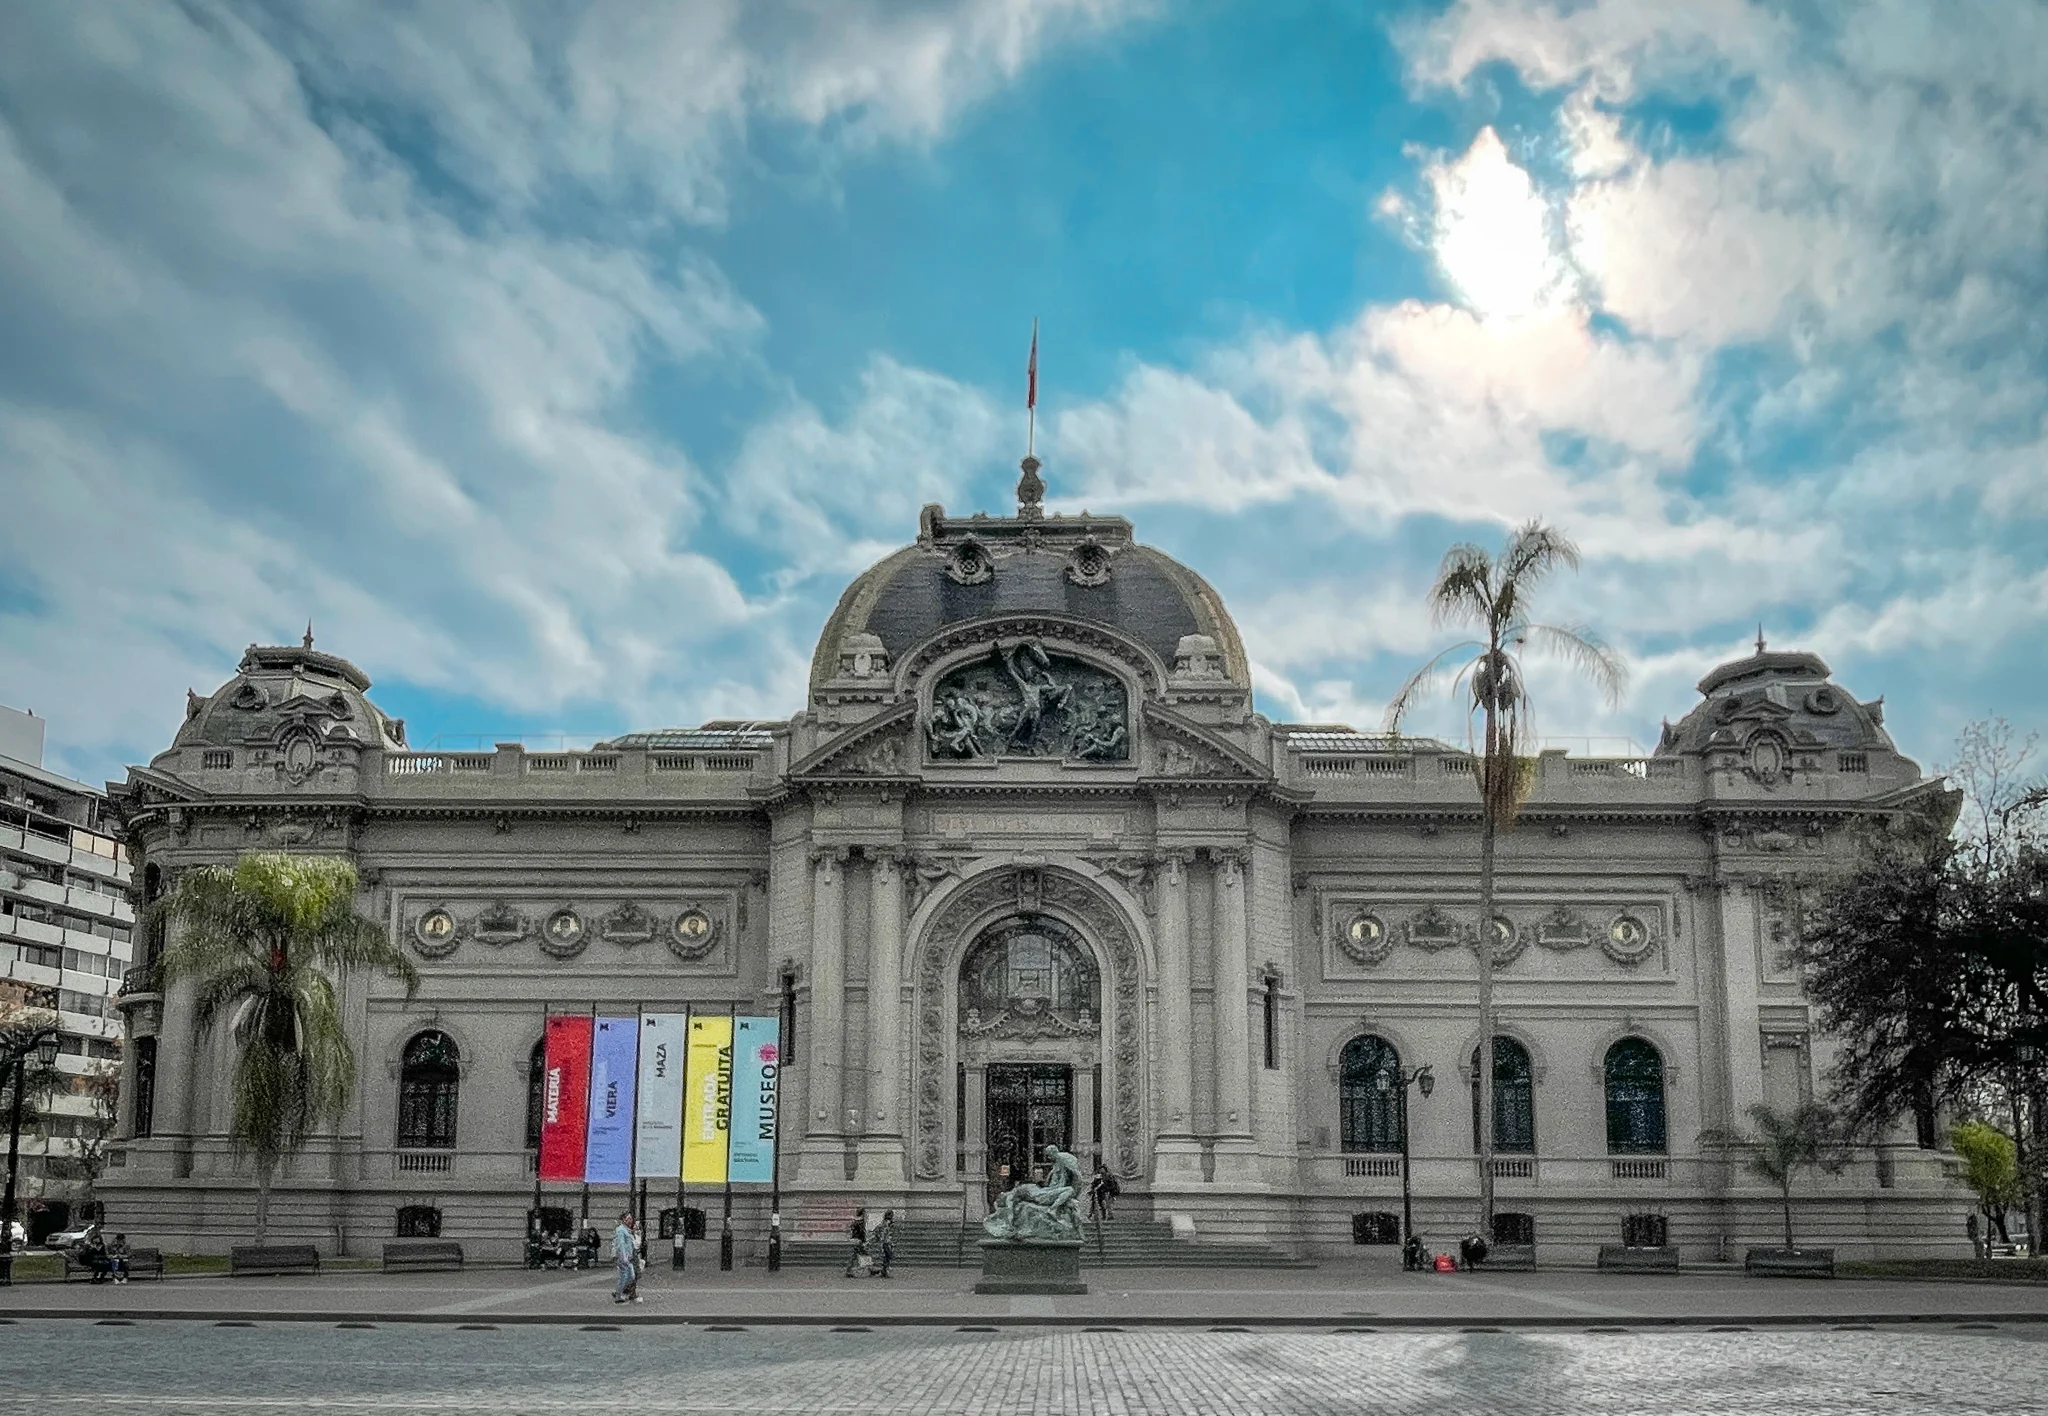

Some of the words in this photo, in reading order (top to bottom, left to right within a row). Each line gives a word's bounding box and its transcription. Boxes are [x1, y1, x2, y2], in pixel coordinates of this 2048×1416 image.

[655, 1042, 667, 1078] MAZA
[716, 1046, 731, 1131] GRATUITA
[605, 1080, 618, 1118] VIERA
[702, 1072, 717, 1140] ENTRADA
[759, 1063, 777, 1140] MUSEO
